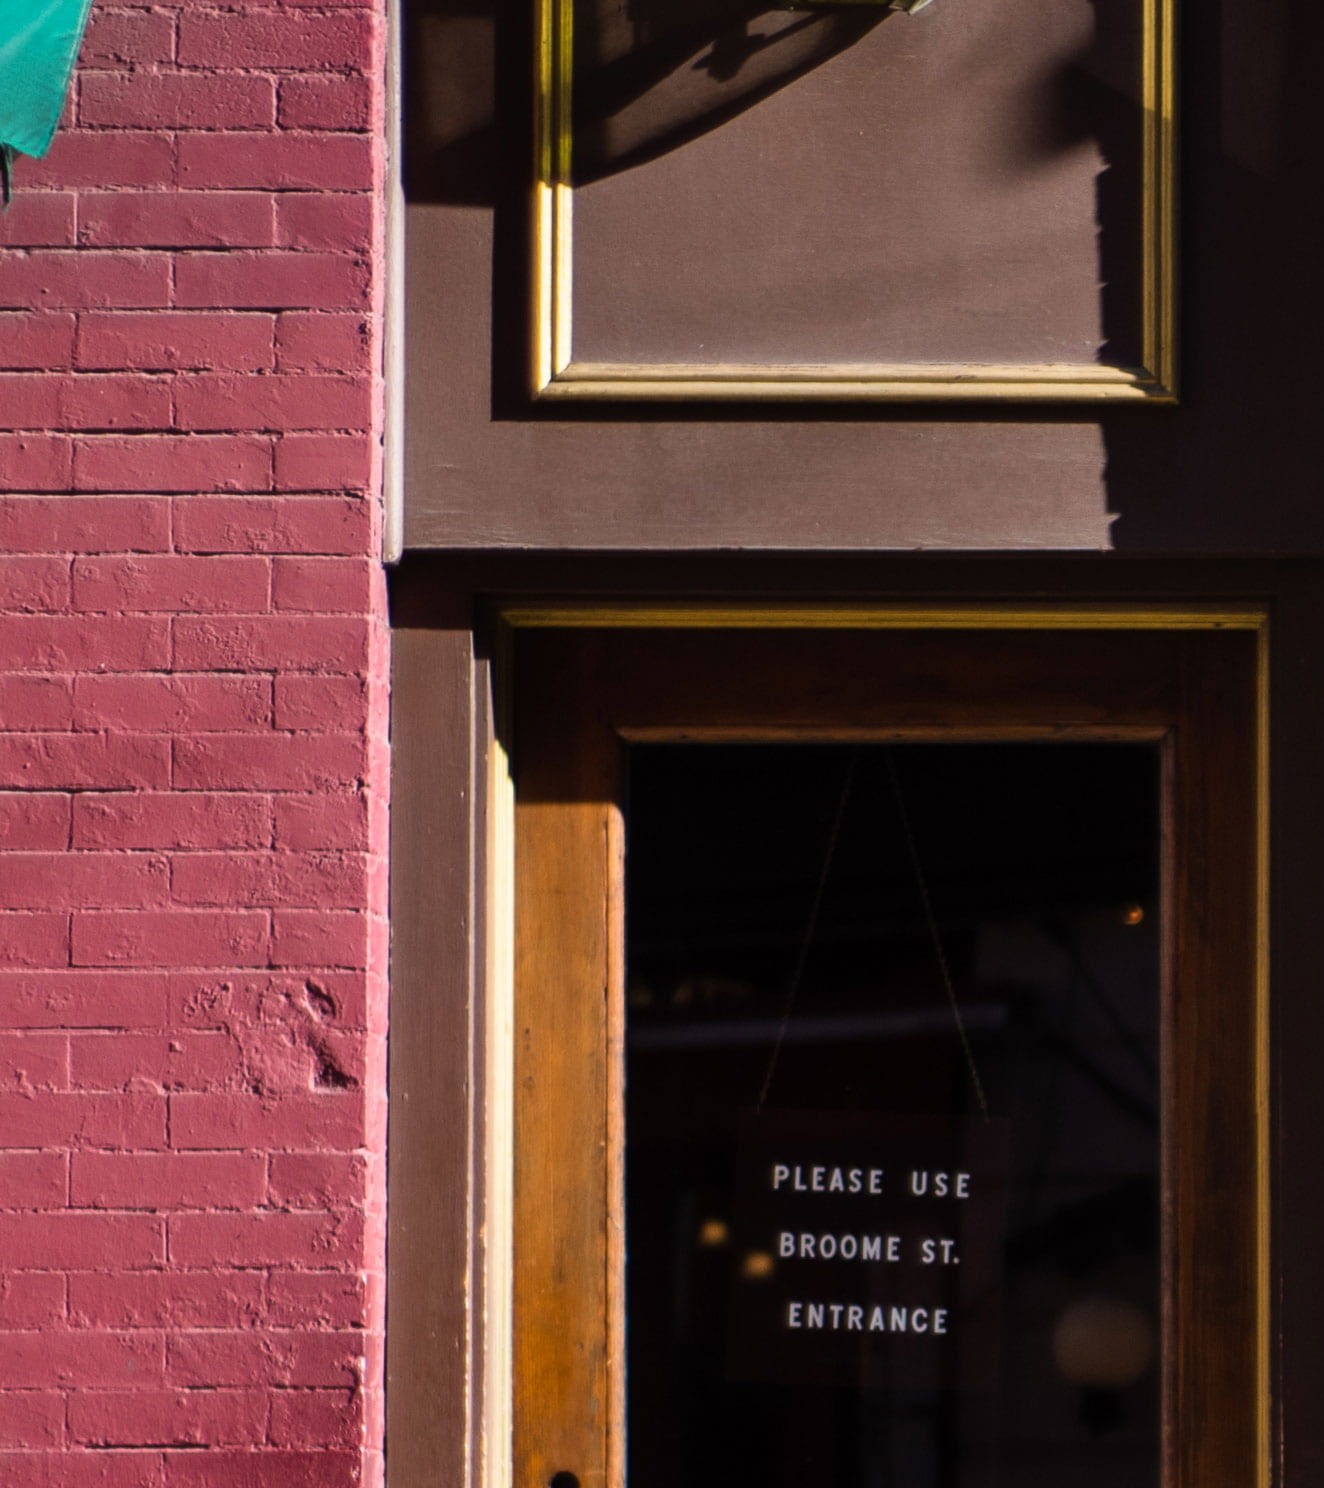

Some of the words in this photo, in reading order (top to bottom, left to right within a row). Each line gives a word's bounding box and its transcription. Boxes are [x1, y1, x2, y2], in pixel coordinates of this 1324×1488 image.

[773, 1164, 884, 1195] PLEASE
[911, 1170, 971, 1199] USE
[779, 1231, 901, 1262] BROOME
[921, 1239, 961, 1265] ST.
[788, 1302, 948, 1335] ENTRANCE
